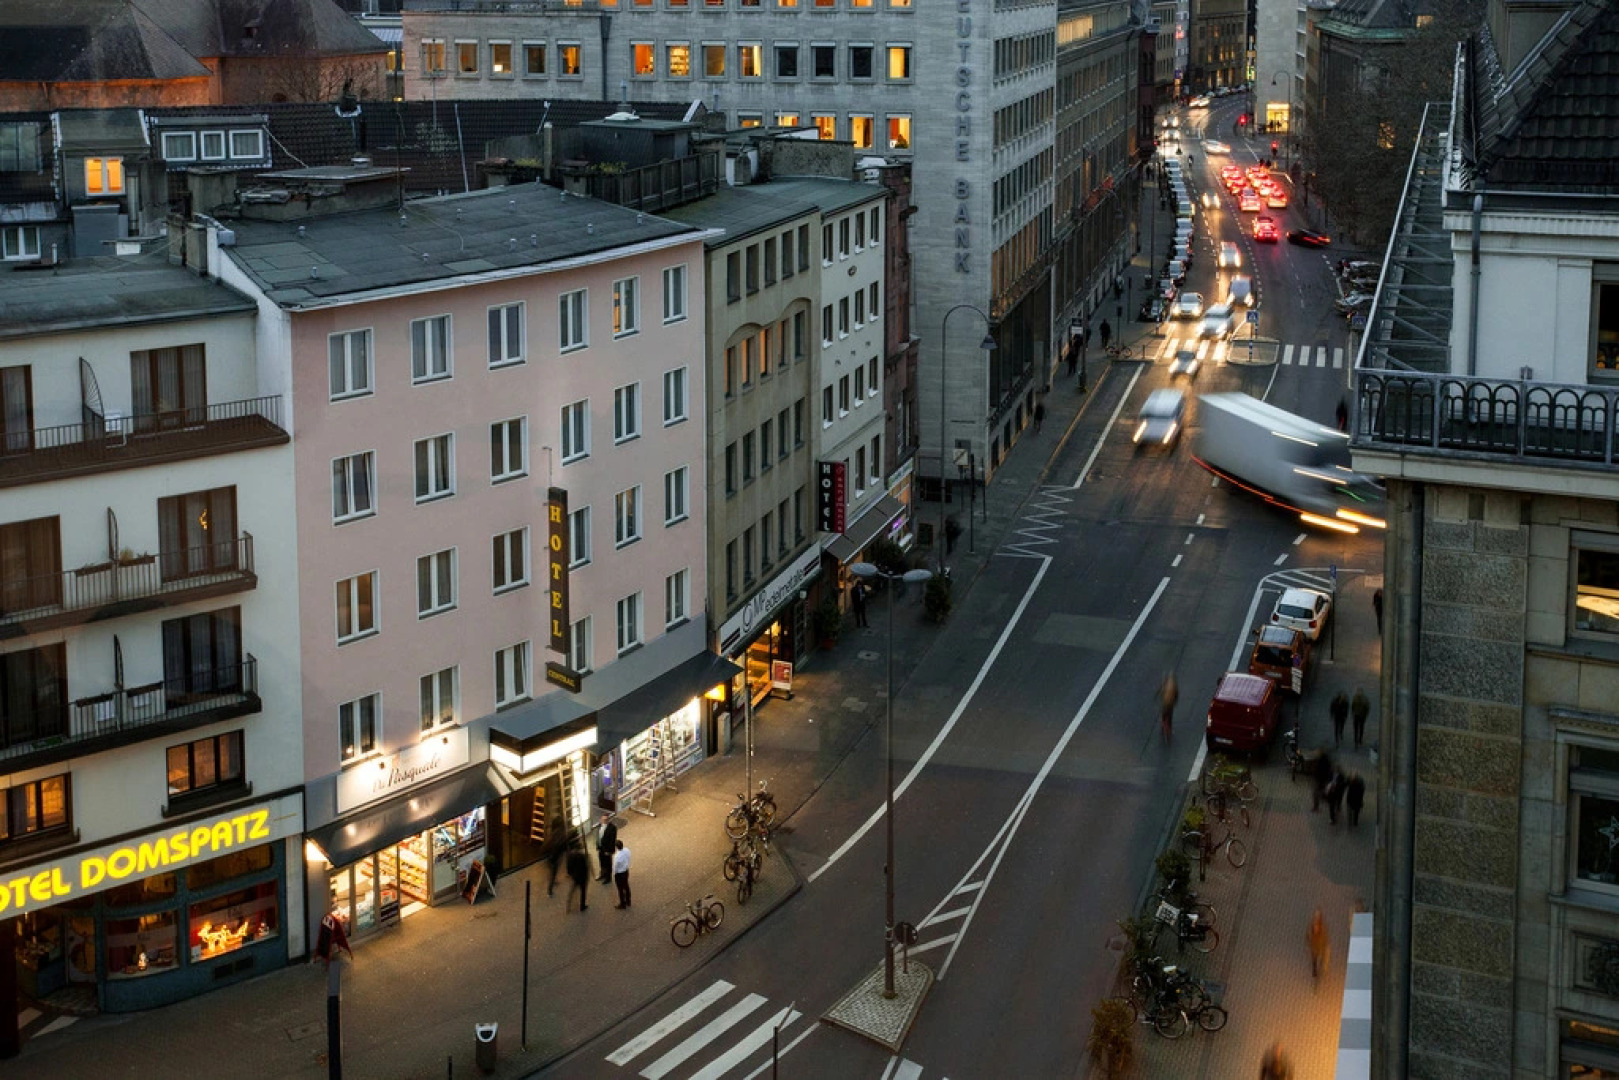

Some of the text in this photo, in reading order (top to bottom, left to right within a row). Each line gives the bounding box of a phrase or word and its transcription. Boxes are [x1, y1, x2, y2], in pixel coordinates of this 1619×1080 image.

[954, 177, 971, 274] BANK
[821, 464, 832, 532] HOTEL
[549, 505, 563, 638] HOTEL
[80, 807, 271, 889] DOMSPATZ
